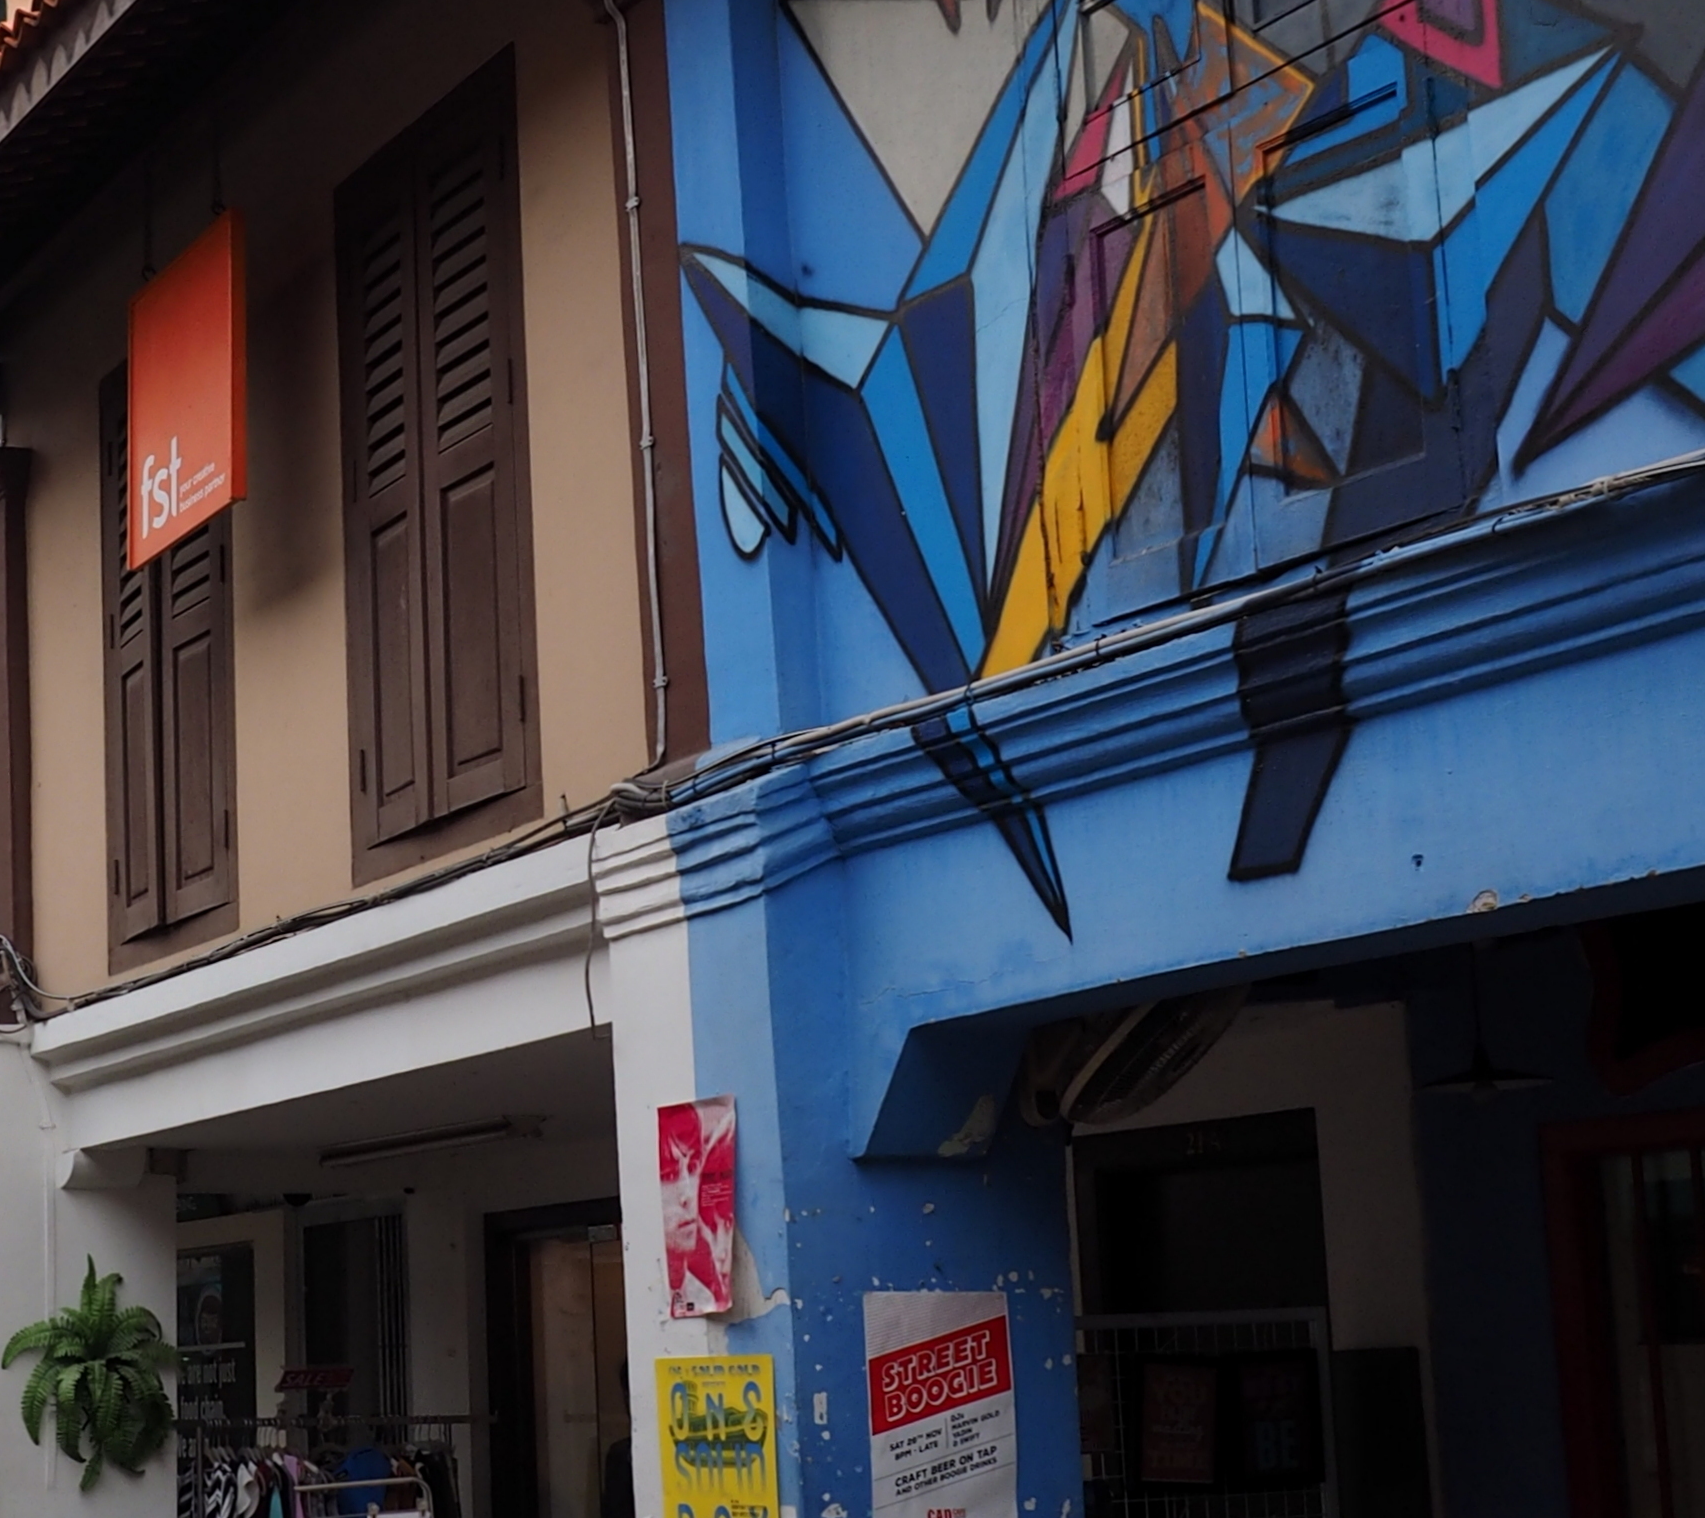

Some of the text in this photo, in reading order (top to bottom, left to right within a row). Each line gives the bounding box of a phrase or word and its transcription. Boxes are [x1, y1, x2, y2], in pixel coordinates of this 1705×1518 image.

[141, 436, 181, 539] fst
[285, 1372, 325, 1387] SALE
[882, 1329, 990, 1393] STREET
[884, 1358, 997, 1422] BOOGIE
[890, 1440, 904, 1451] SAT
[925, 1428, 943, 1440] NOV
[951, 1417, 979, 1430] MARVIN
[895, 1445, 998, 1487] CRAFT BEER ON TAP
[918, 1440, 939, 1453] LATE
[895, 1457, 998, 1497] AND OTHER BOOGIE DRINKS
